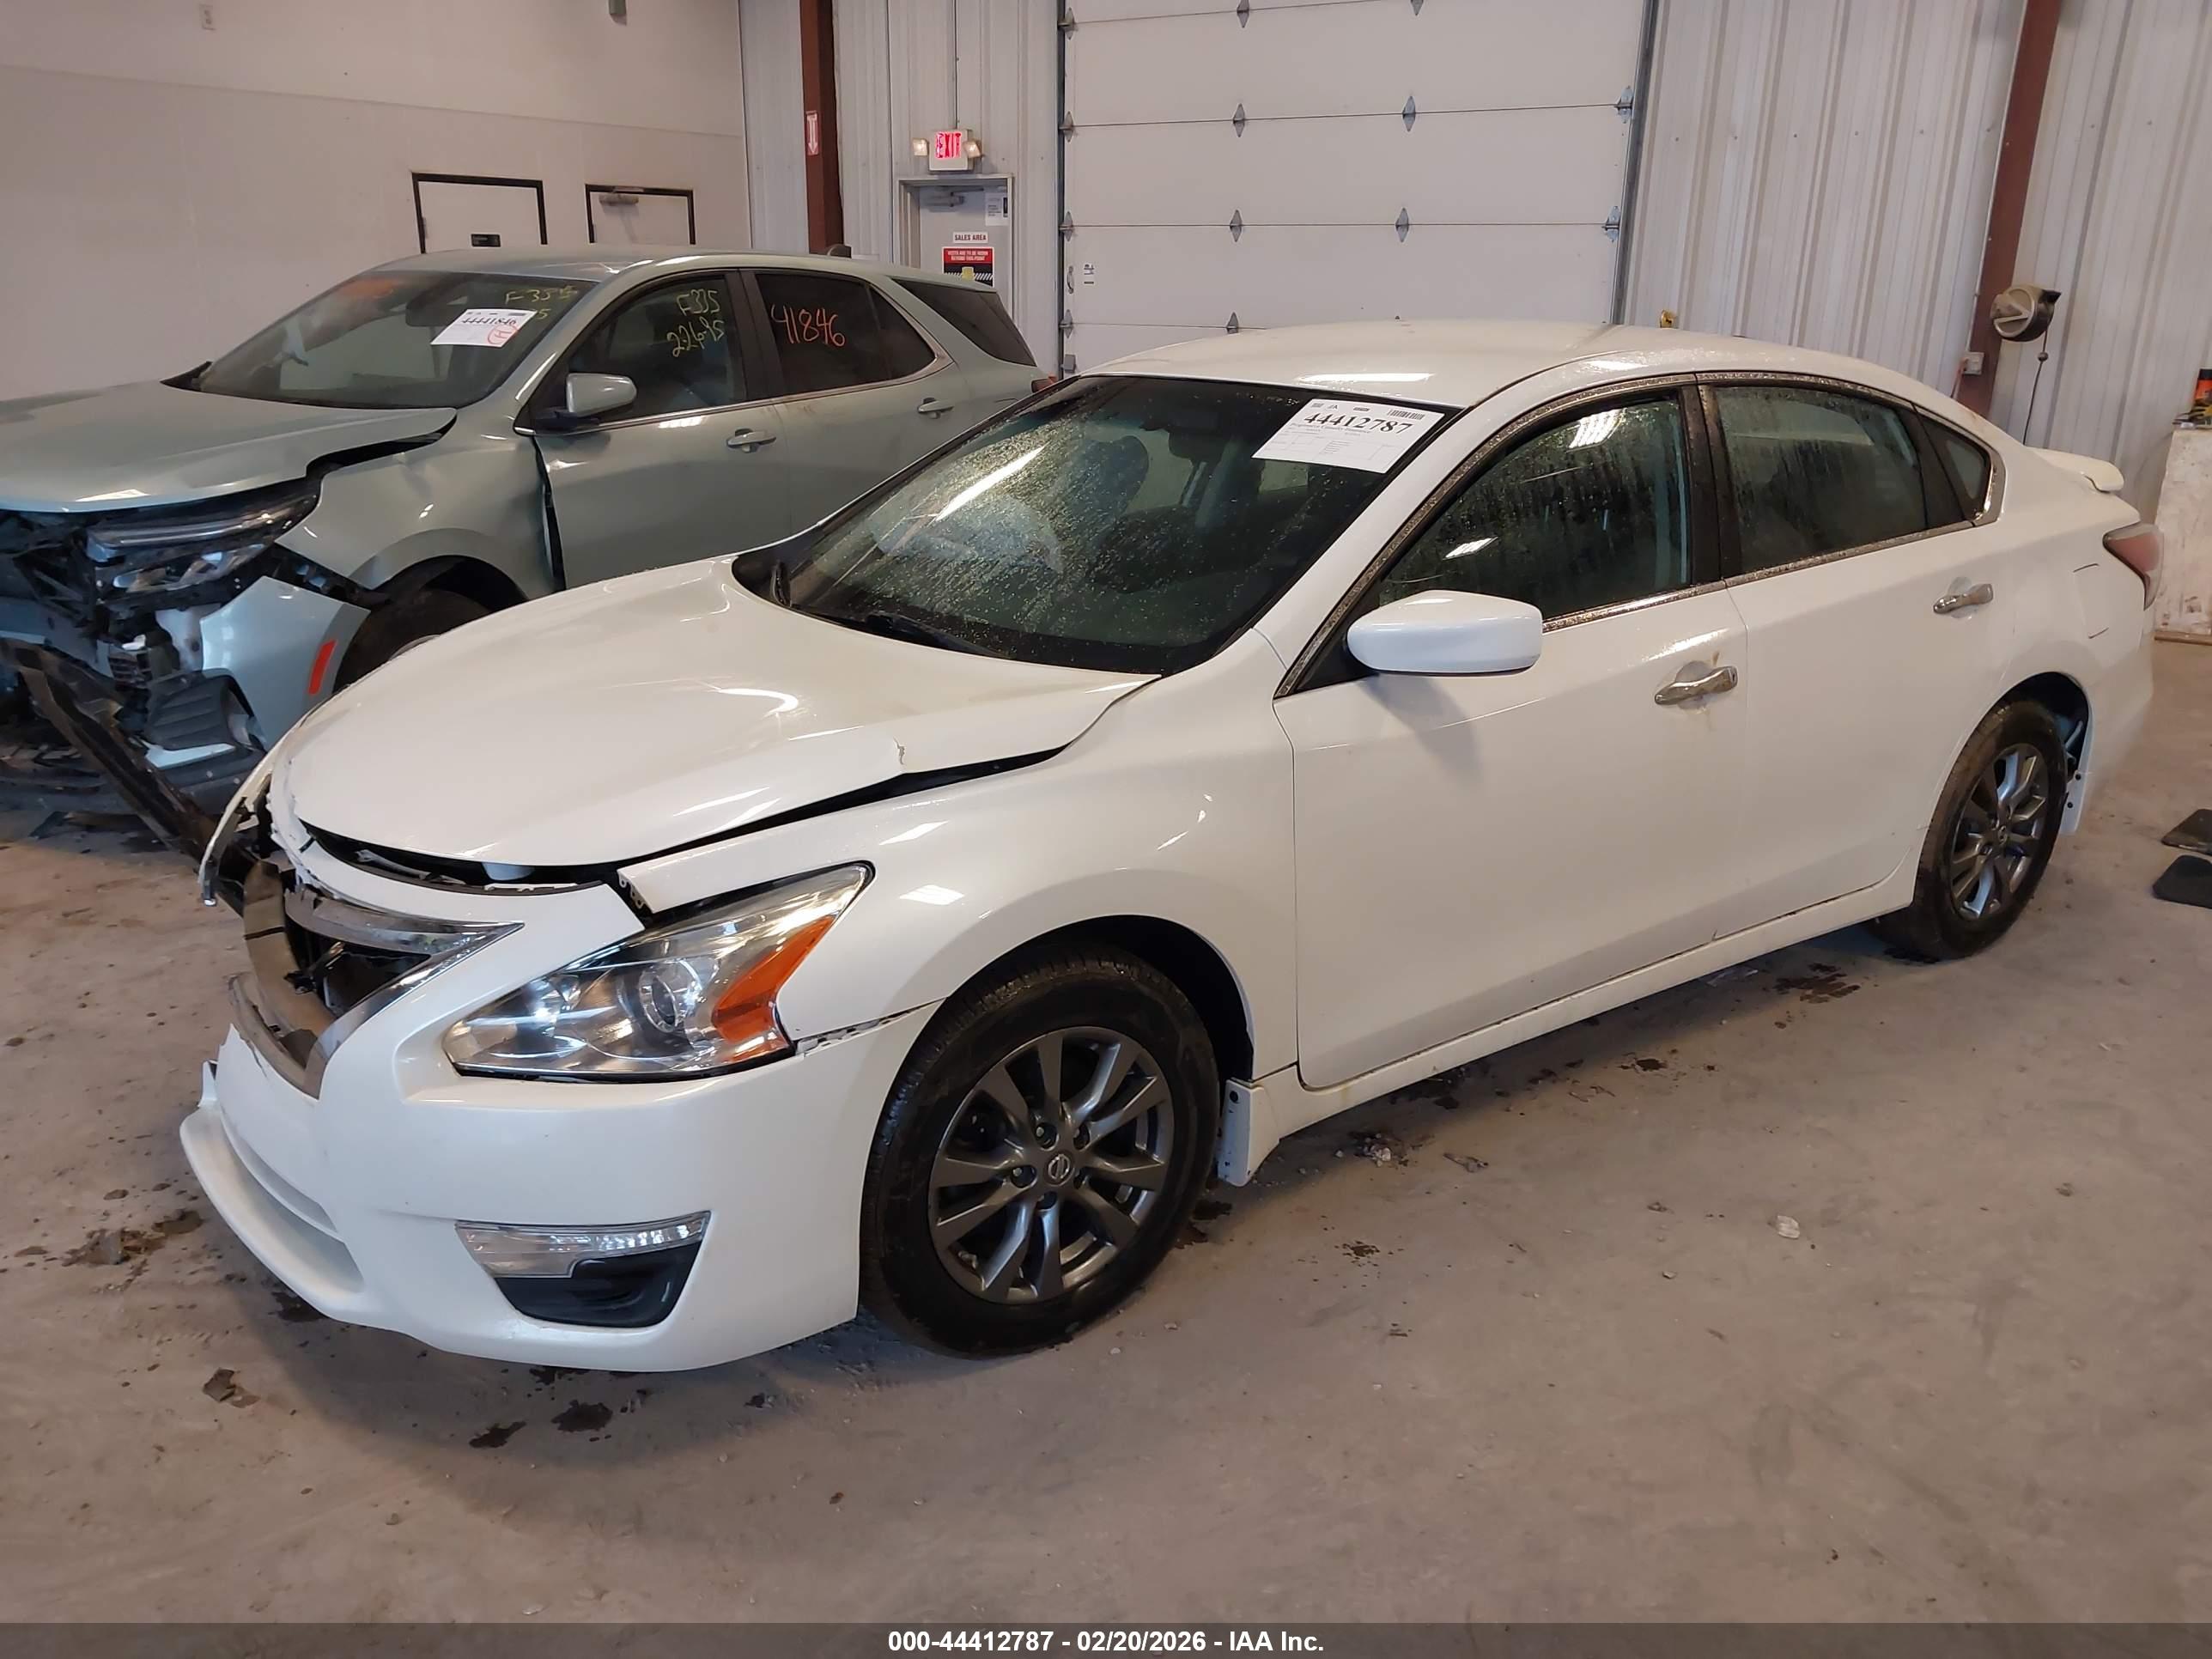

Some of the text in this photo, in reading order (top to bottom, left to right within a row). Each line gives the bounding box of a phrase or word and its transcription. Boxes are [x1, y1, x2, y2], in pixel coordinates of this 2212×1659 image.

[936, 132, 961, 158] EXIT
[770, 304, 845, 347] 41846
[1304, 412, 1413, 434] 44412787
